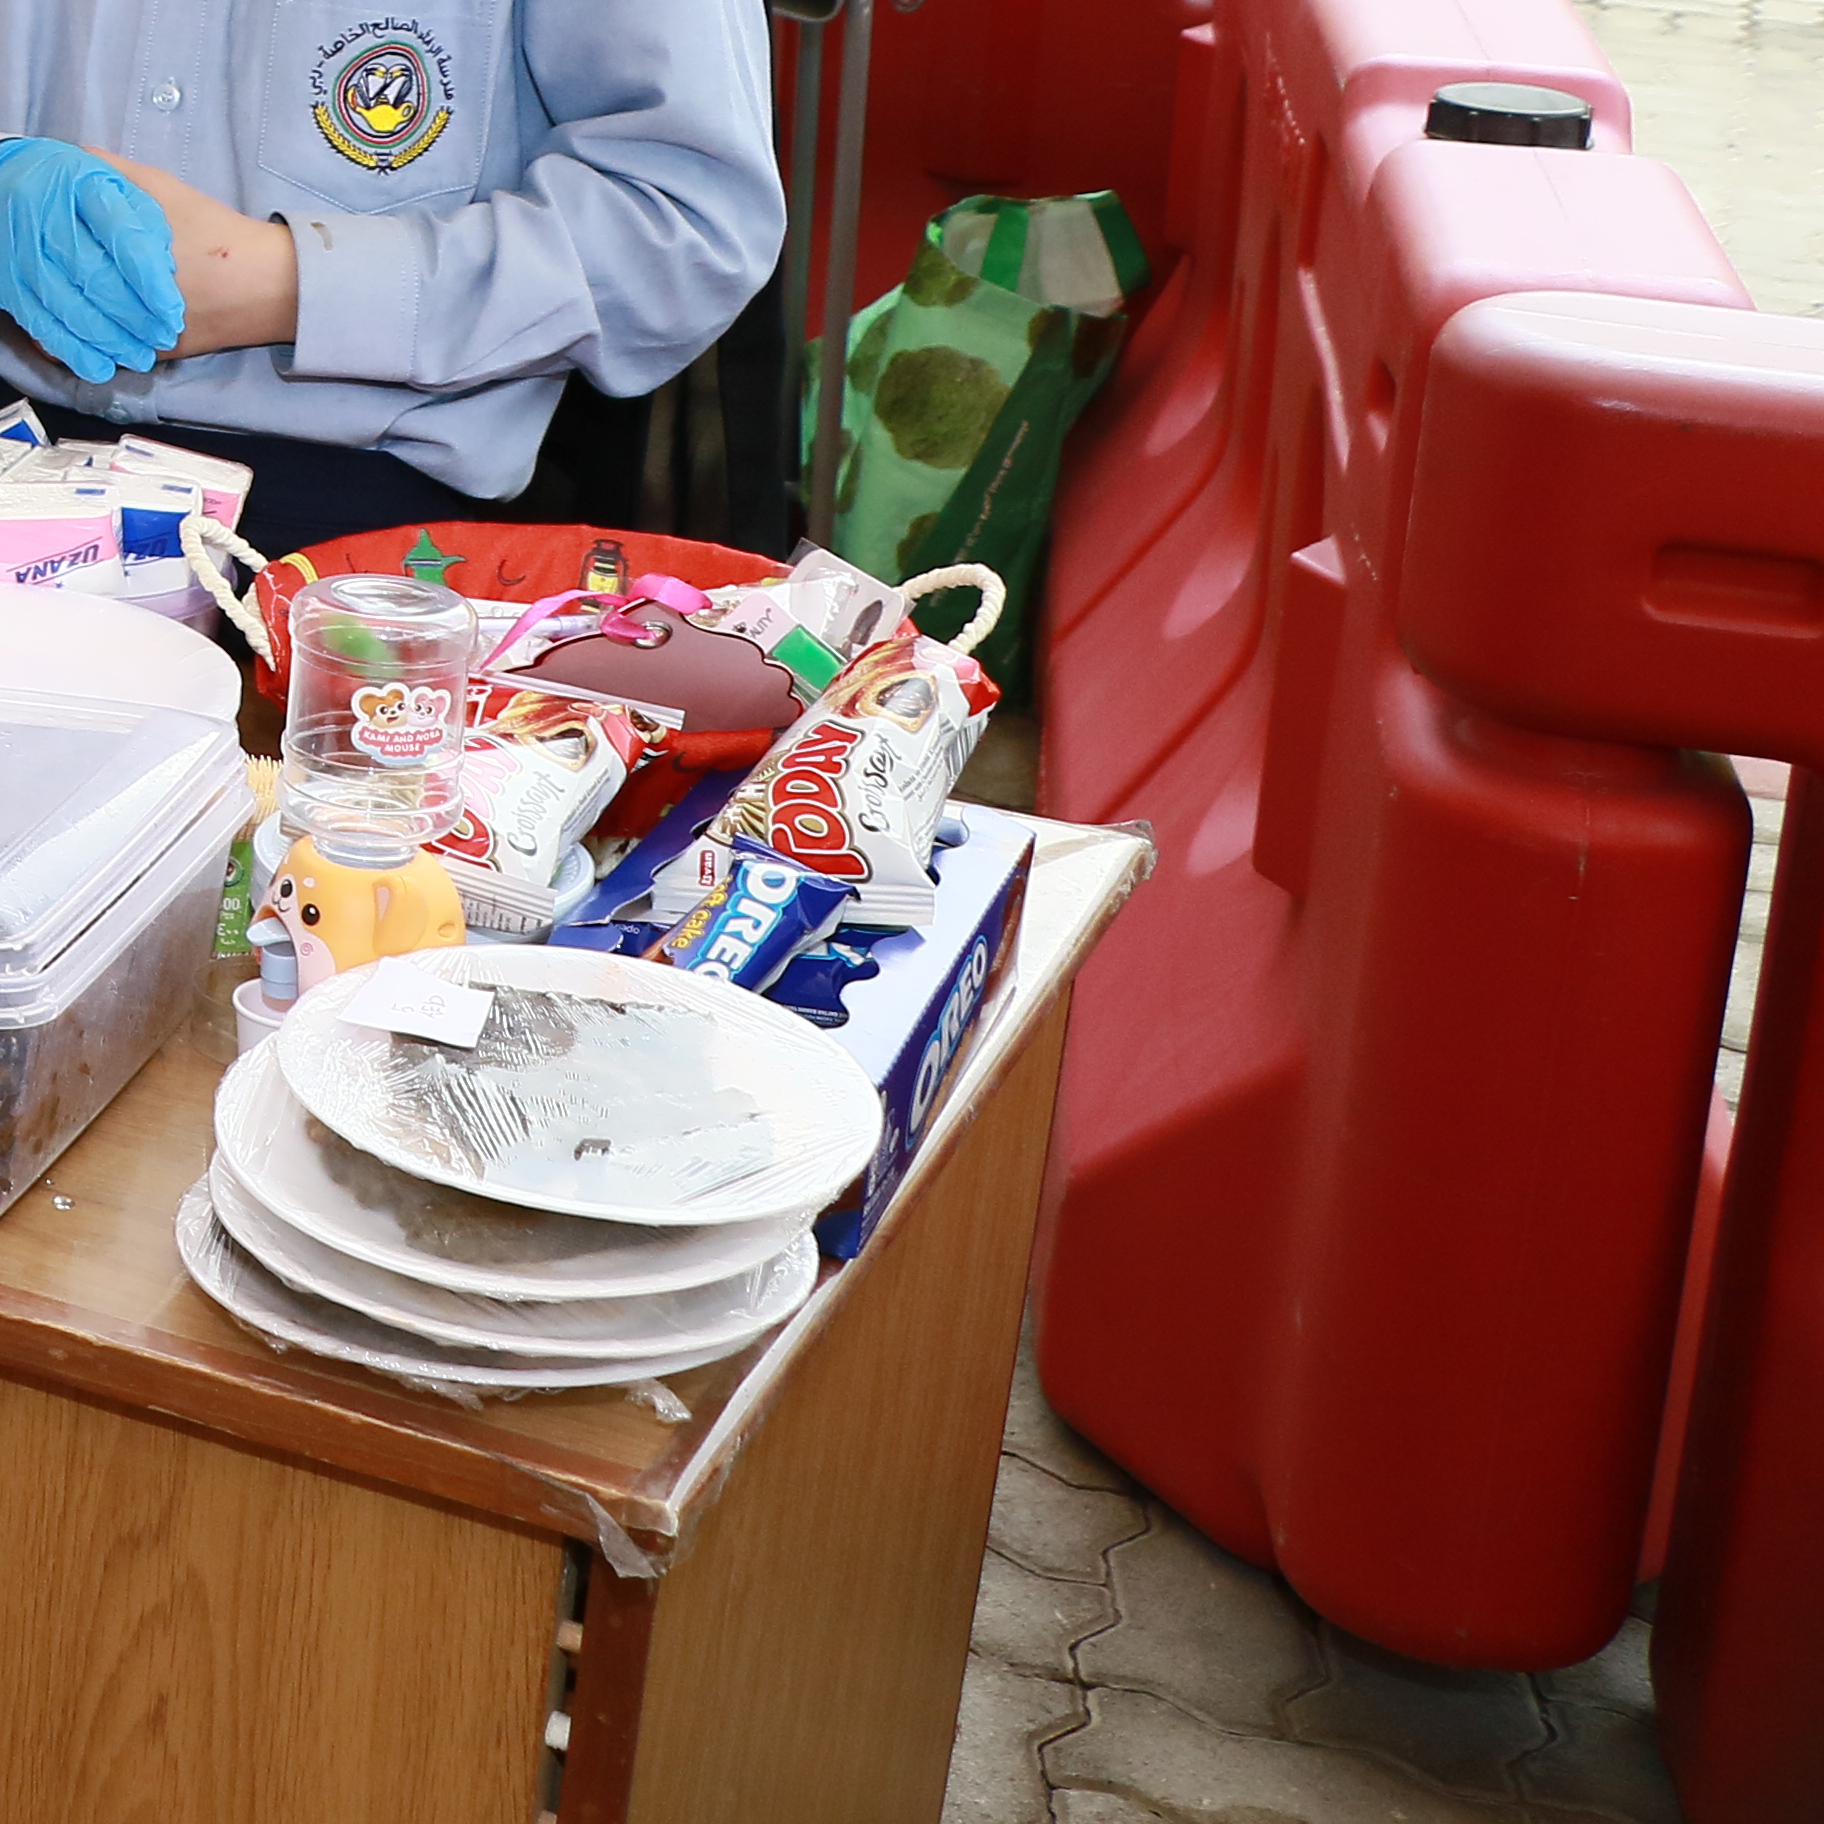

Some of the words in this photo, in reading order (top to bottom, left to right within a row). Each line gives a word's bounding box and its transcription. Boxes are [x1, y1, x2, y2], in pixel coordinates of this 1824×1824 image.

[15, 542, 100, 585] UZANA
[362, 730, 391, 743] KAMI
[392, 732, 414, 743] AND
[384, 742, 421, 753] MOUSE
[770, 720, 868, 880] TODAY
[671, 907, 711, 950] cake
[908, 936, 988, 1136] OREO
